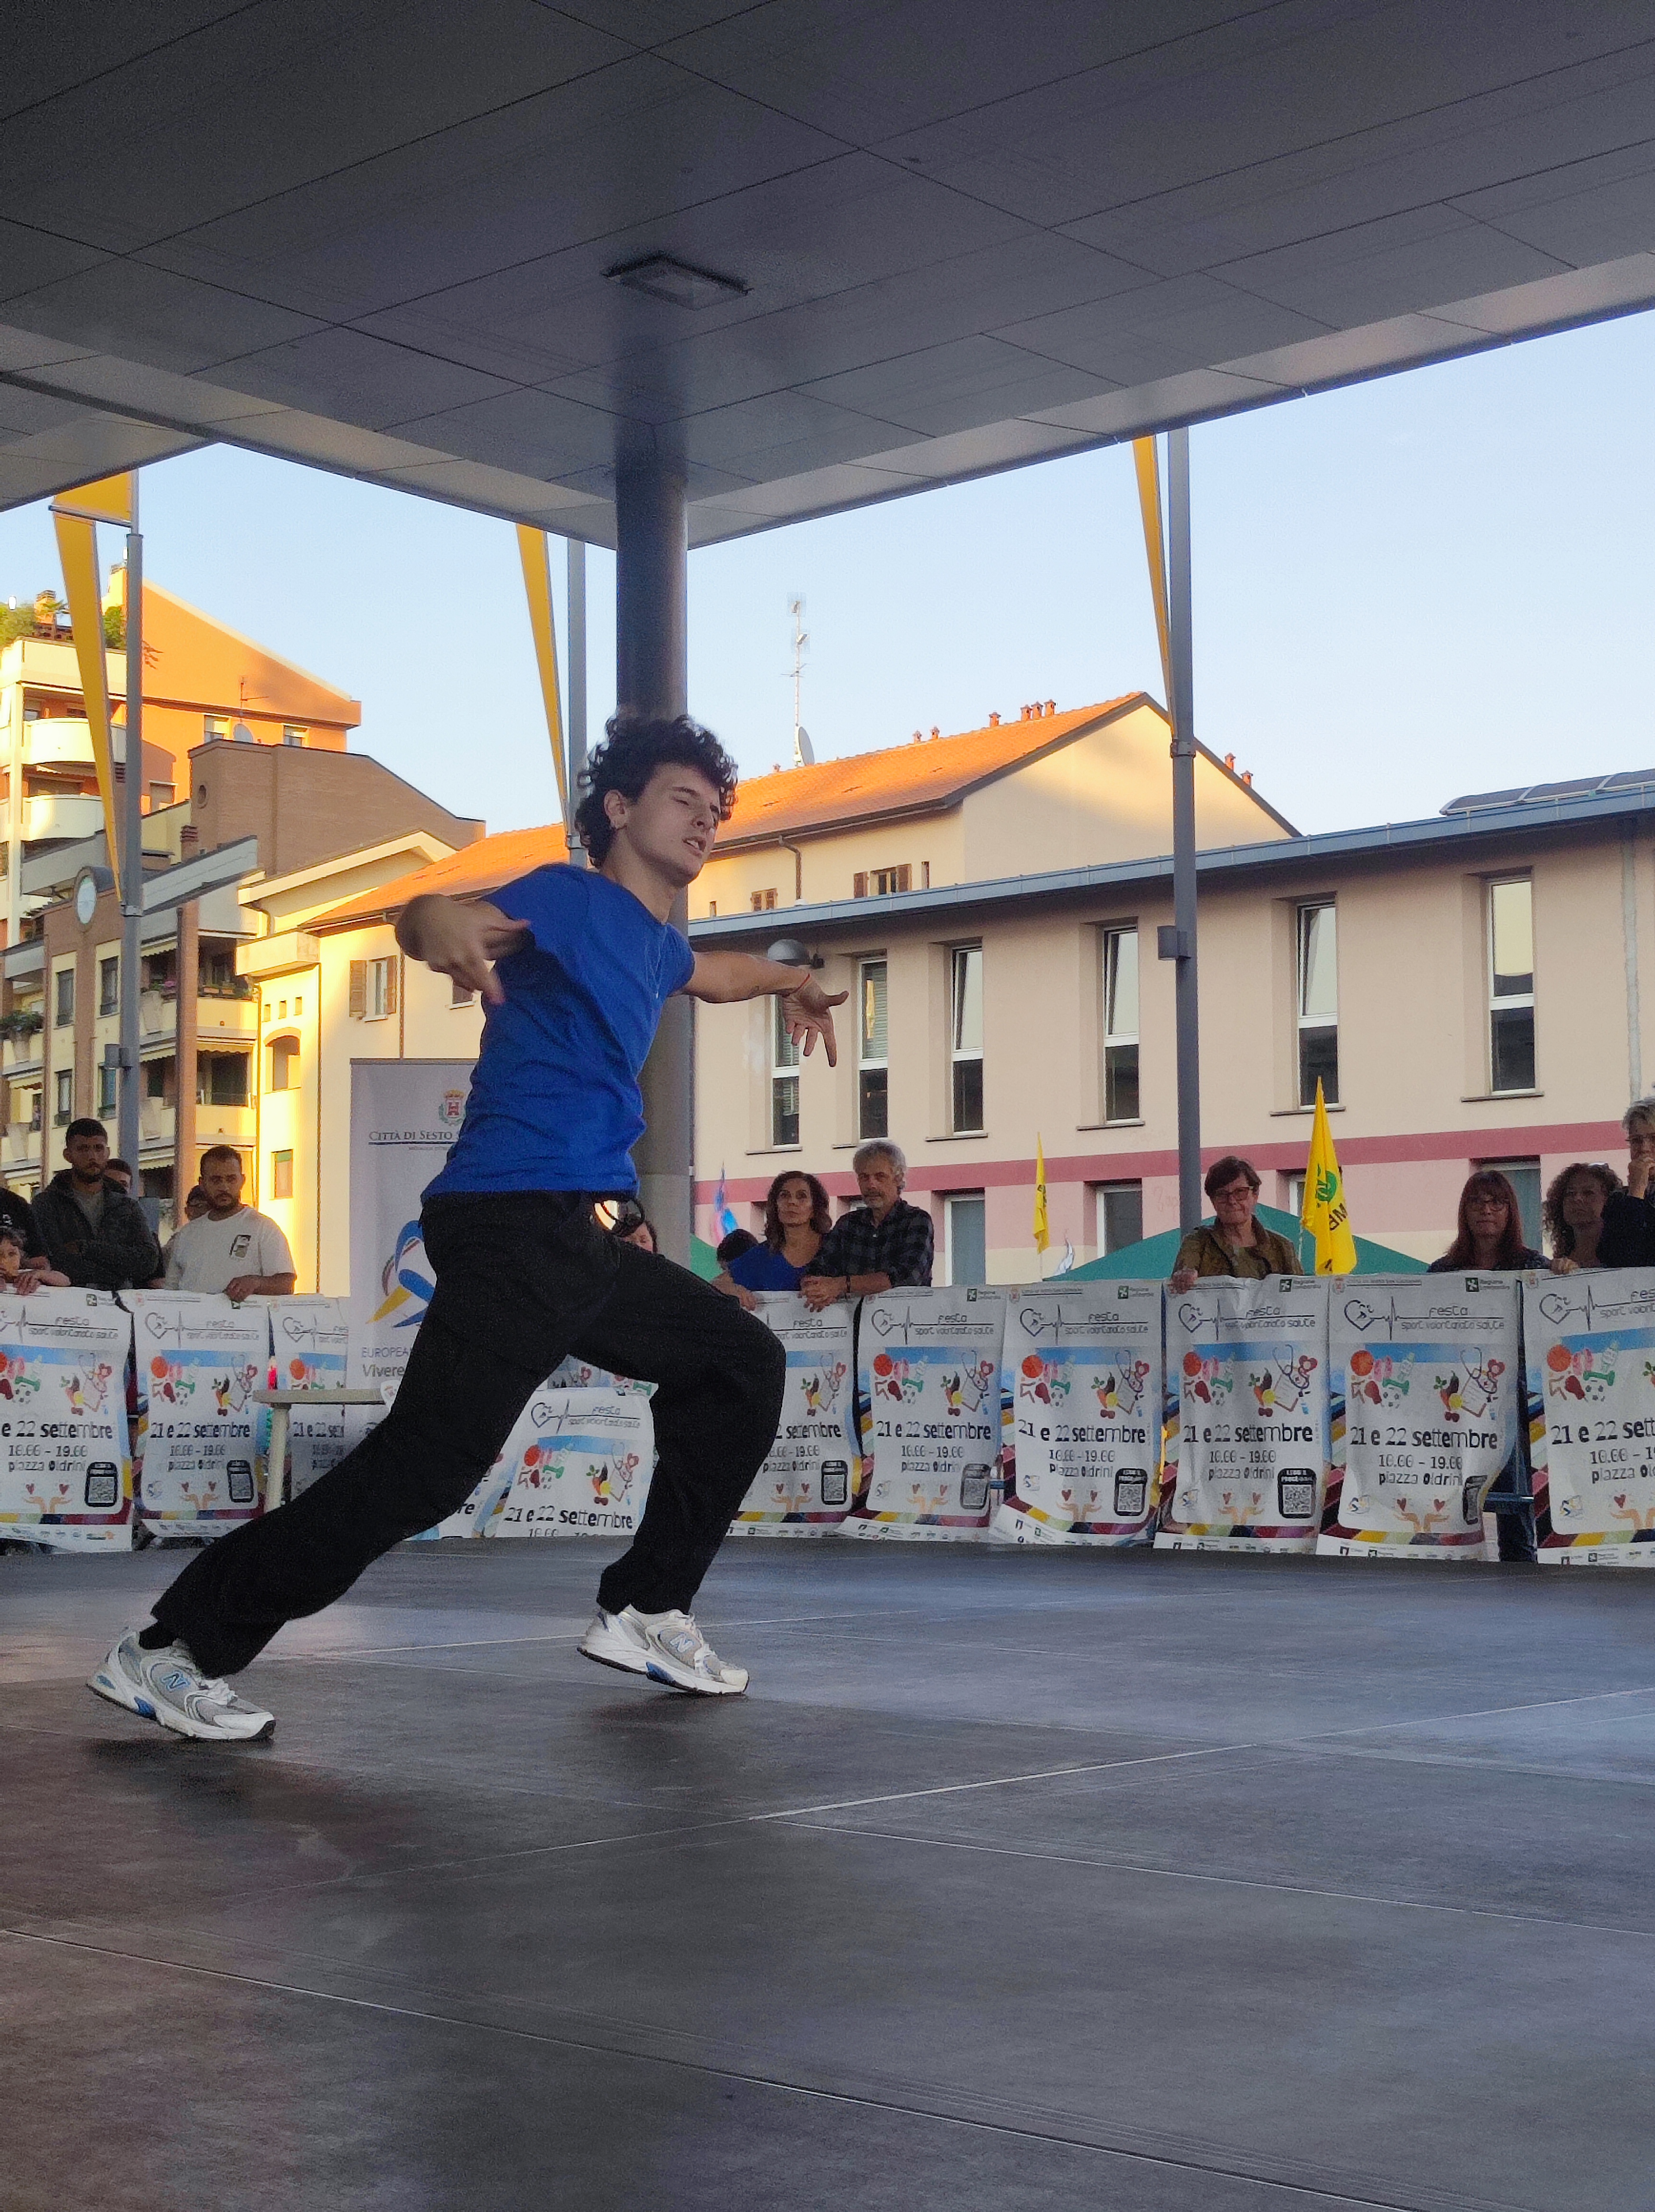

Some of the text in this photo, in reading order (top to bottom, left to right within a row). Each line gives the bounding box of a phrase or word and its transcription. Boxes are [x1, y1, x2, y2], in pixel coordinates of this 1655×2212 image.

[404, 1131, 416, 1140] DI
[419, 1130, 453, 1140] SESTO
[361, 1346, 409, 1358] EUROPEA
[1, 1420, 113, 1439] e 22 settembre
[150, 1422, 164, 1438] 21
[167, 1424, 174, 1438] e
[176, 1422, 191, 1438] 22
[876, 1420, 991, 1440] 21 e 22 settembre
[1018, 1419, 1146, 1444] 21 e 22 settembre
[1183, 1423, 1313, 1443] 21 e 22 settembre
[1350, 1426, 1498, 1450] 21 e 22 settembre
[1550, 1425, 1574, 1445] 21
[1578, 1426, 1590, 1443] e
[1594, 1420, 1618, 1441] 22
[1379, 1471, 1419, 1486] piazza
[1592, 1467, 1635, 1484] piazza
[504, 1505, 633, 1529] 21 e 22 settembre
